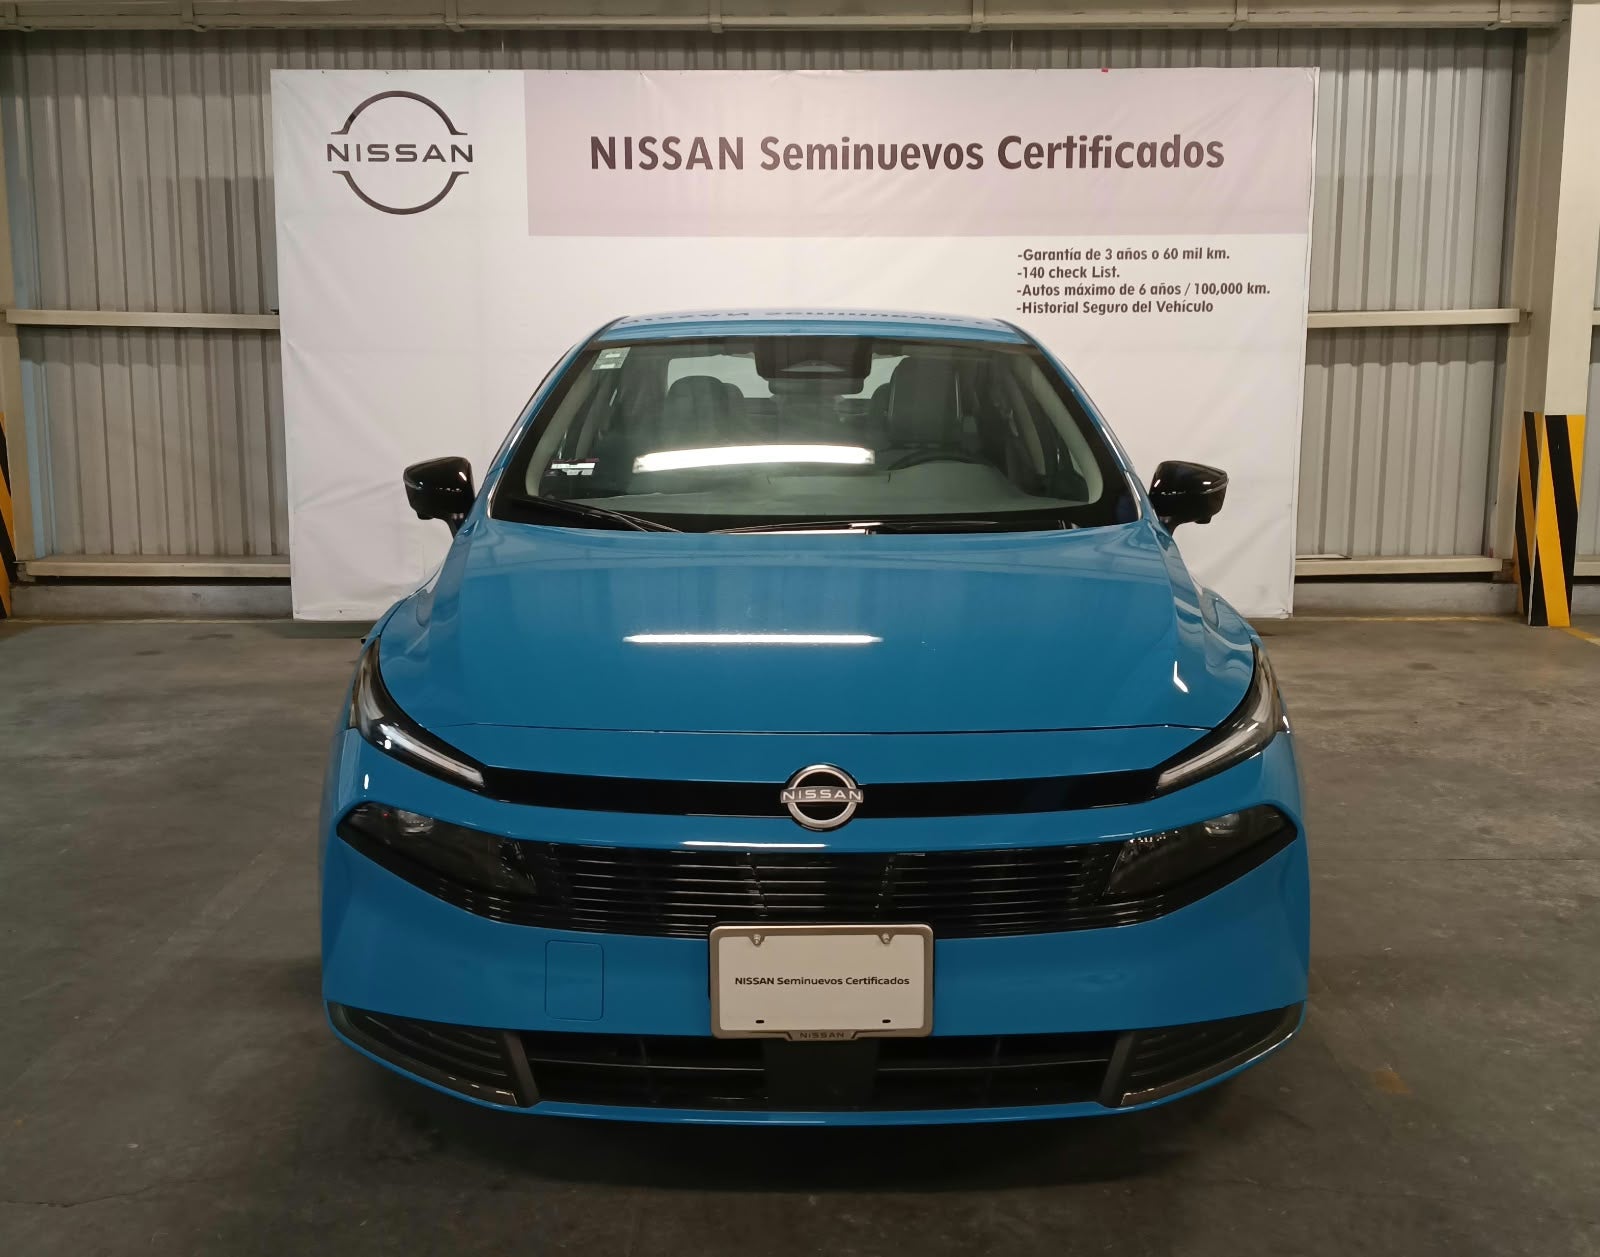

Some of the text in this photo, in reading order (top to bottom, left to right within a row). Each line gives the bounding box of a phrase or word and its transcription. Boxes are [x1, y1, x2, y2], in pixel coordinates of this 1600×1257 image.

[326, 143, 474, 163] NISSAN
[590, 133, 1225, 171] NISSAN Seminuevos Certificados
[1017, 246, 1230, 262] -Garantía de 3 años o 60 mil km.
[1017, 265, 1120, 279] -140 check List.
[1016, 283, 1061, 297] -Autos
[1064, 281, 1116, 296] máximo
[1119, 283, 1136, 296] de
[1138, 283, 1147, 296] 6
[1149, 282, 1182, 296] años
[1194, 282, 1243, 297] 100,000
[1246, 281, 1271, 295] km.
[1016, 299, 1214, 316] -Historial Seguro del Vehículo
[782, 789, 862, 801] NISSAN
[734, 975, 910, 986] NISSAN Seminuevos Certificados
[799, 1031, 845, 1039] NISSAN
